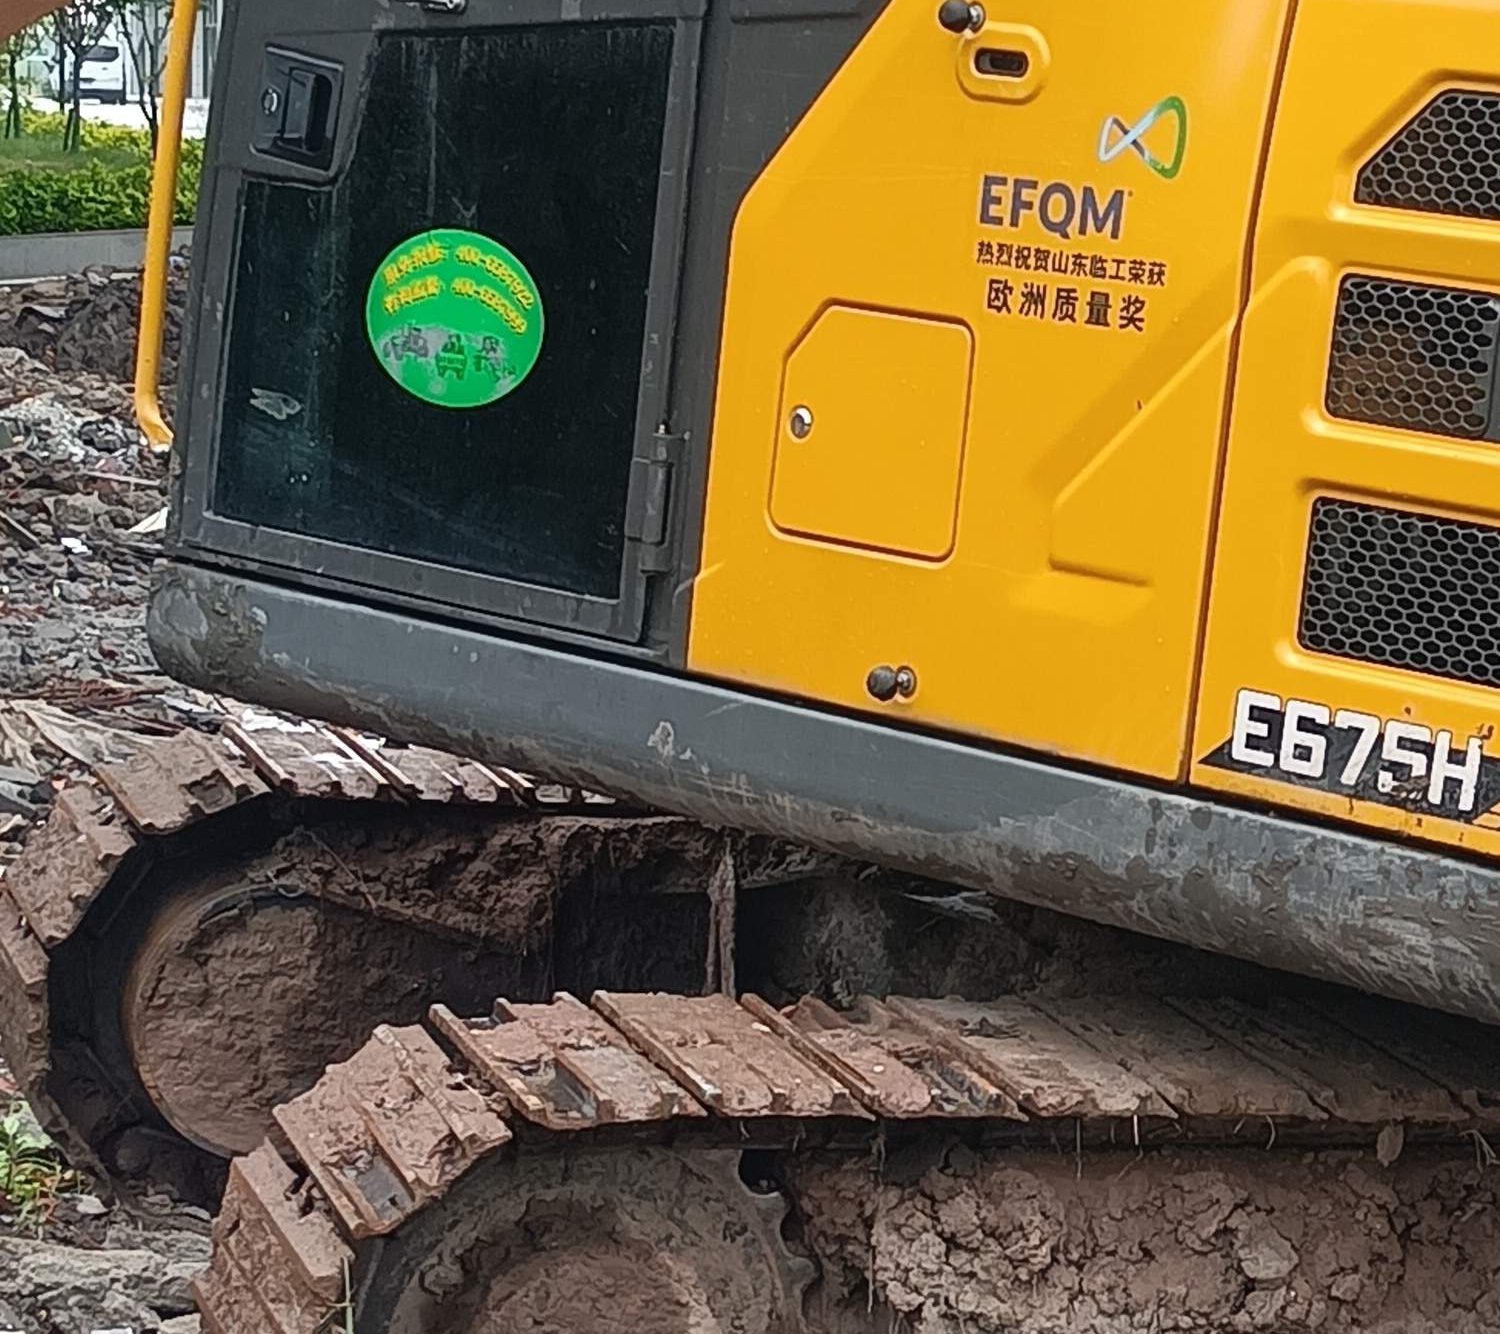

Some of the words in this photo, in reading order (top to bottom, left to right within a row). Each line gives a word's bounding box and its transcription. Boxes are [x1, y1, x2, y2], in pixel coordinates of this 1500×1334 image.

[979, 174, 1126, 240] EFQM
[976, 240, 1167, 287] 热烈祝贺山东临工荣获
[986, 278, 1146, 333] 欧洲质量奖
[1231, 688, 1483, 812] E675H
